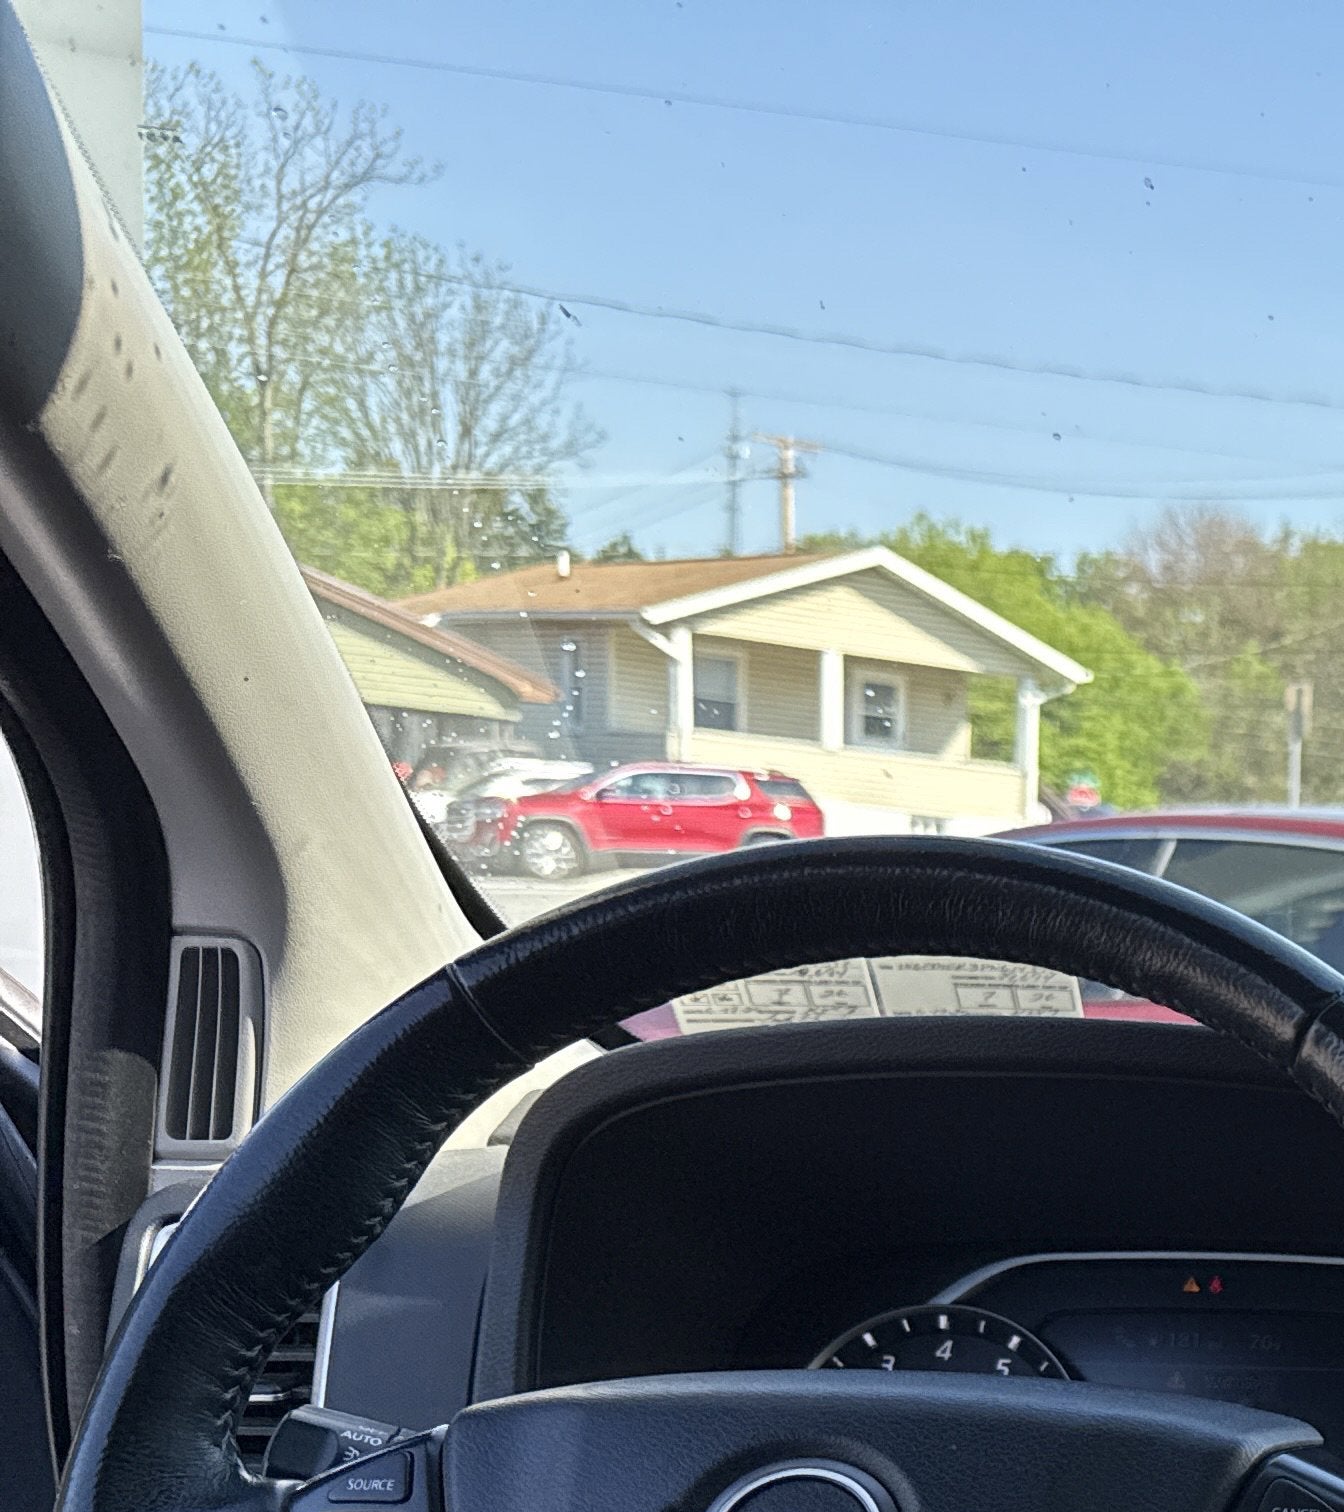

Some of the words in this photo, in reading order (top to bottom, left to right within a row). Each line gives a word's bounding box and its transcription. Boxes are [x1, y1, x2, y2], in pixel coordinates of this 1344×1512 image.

[935, 1340, 954, 1361] 4
[341, 1430, 382, 1446] AUTO
[346, 1478, 395, 1492] SOURCE
